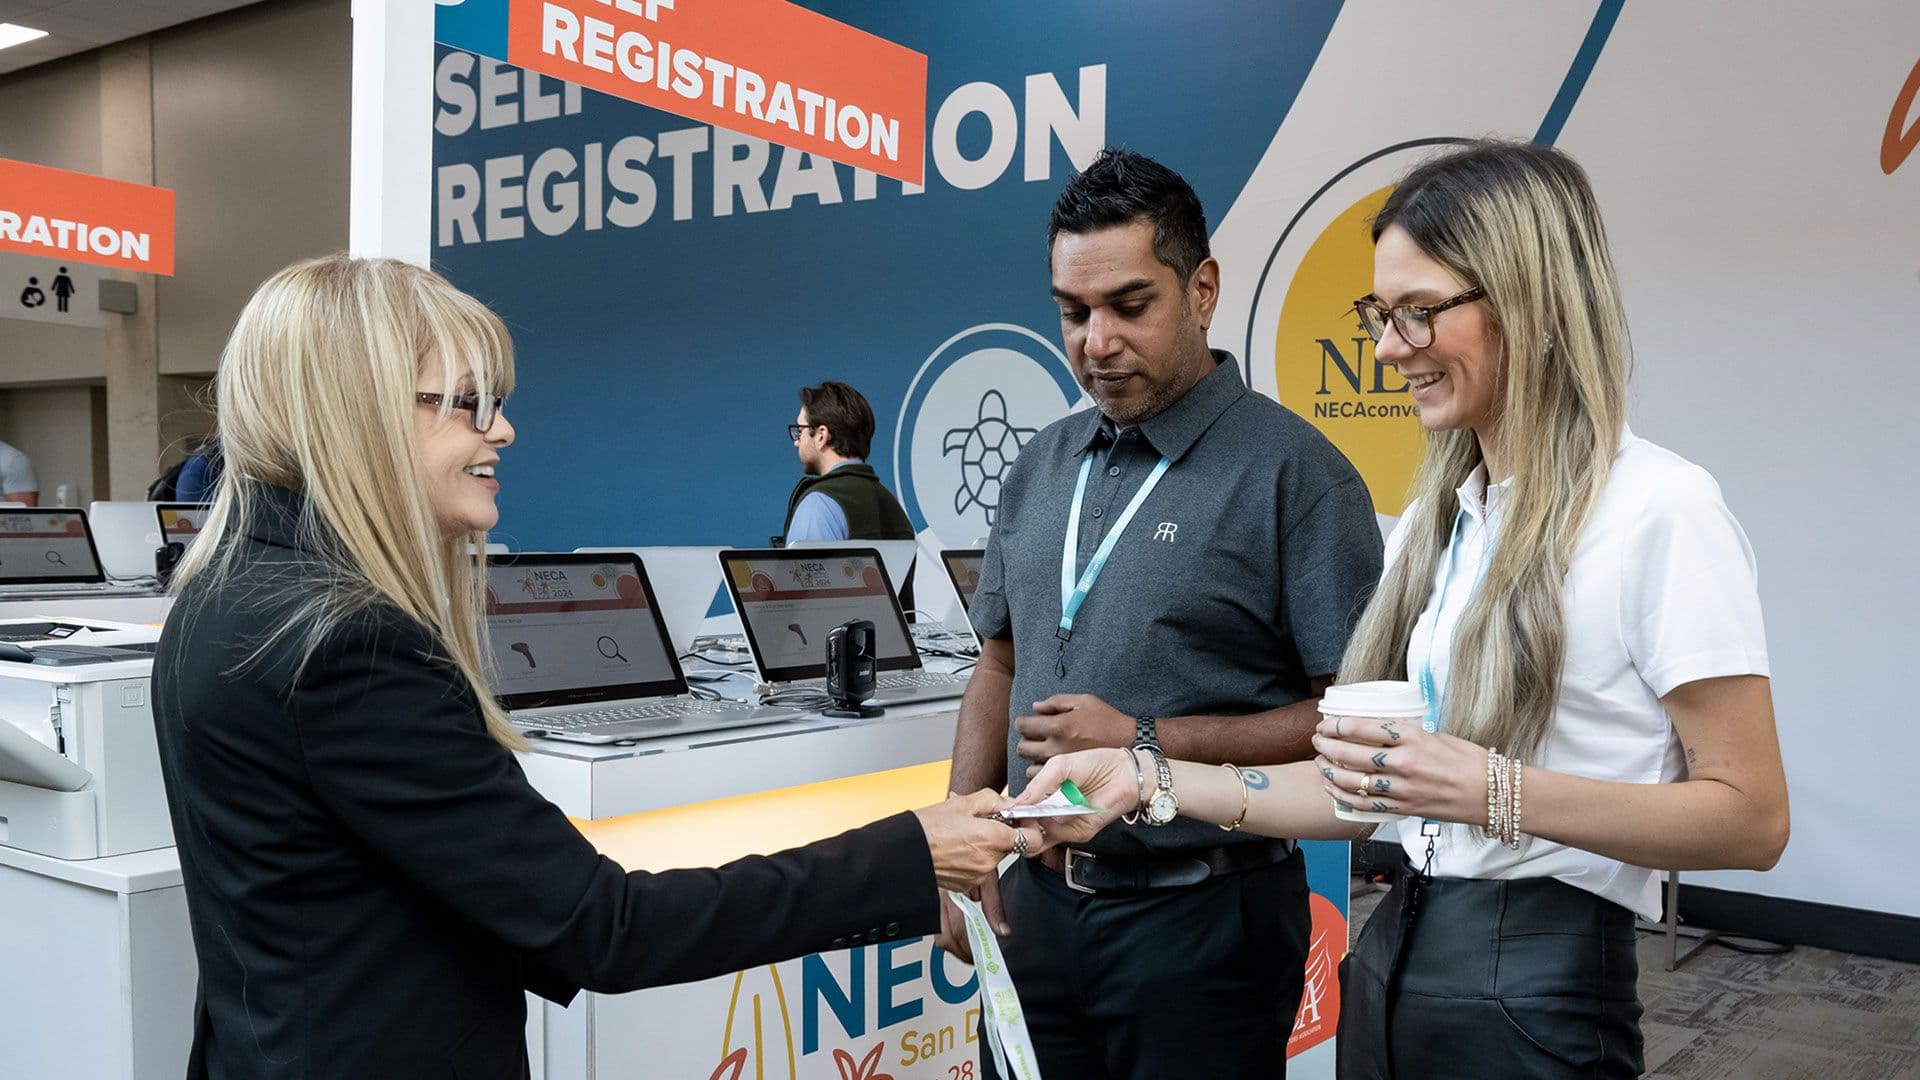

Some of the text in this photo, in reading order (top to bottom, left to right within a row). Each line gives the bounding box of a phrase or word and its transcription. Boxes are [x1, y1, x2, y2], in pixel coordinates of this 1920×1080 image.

[541, 1, 900, 162] REGISTRATION
[437, 63, 1107, 248] REGISTRAON
[534, 570, 568, 582] NECA
[800, 562, 826, 572] NECA
[900, 1025, 954, 1067] San
